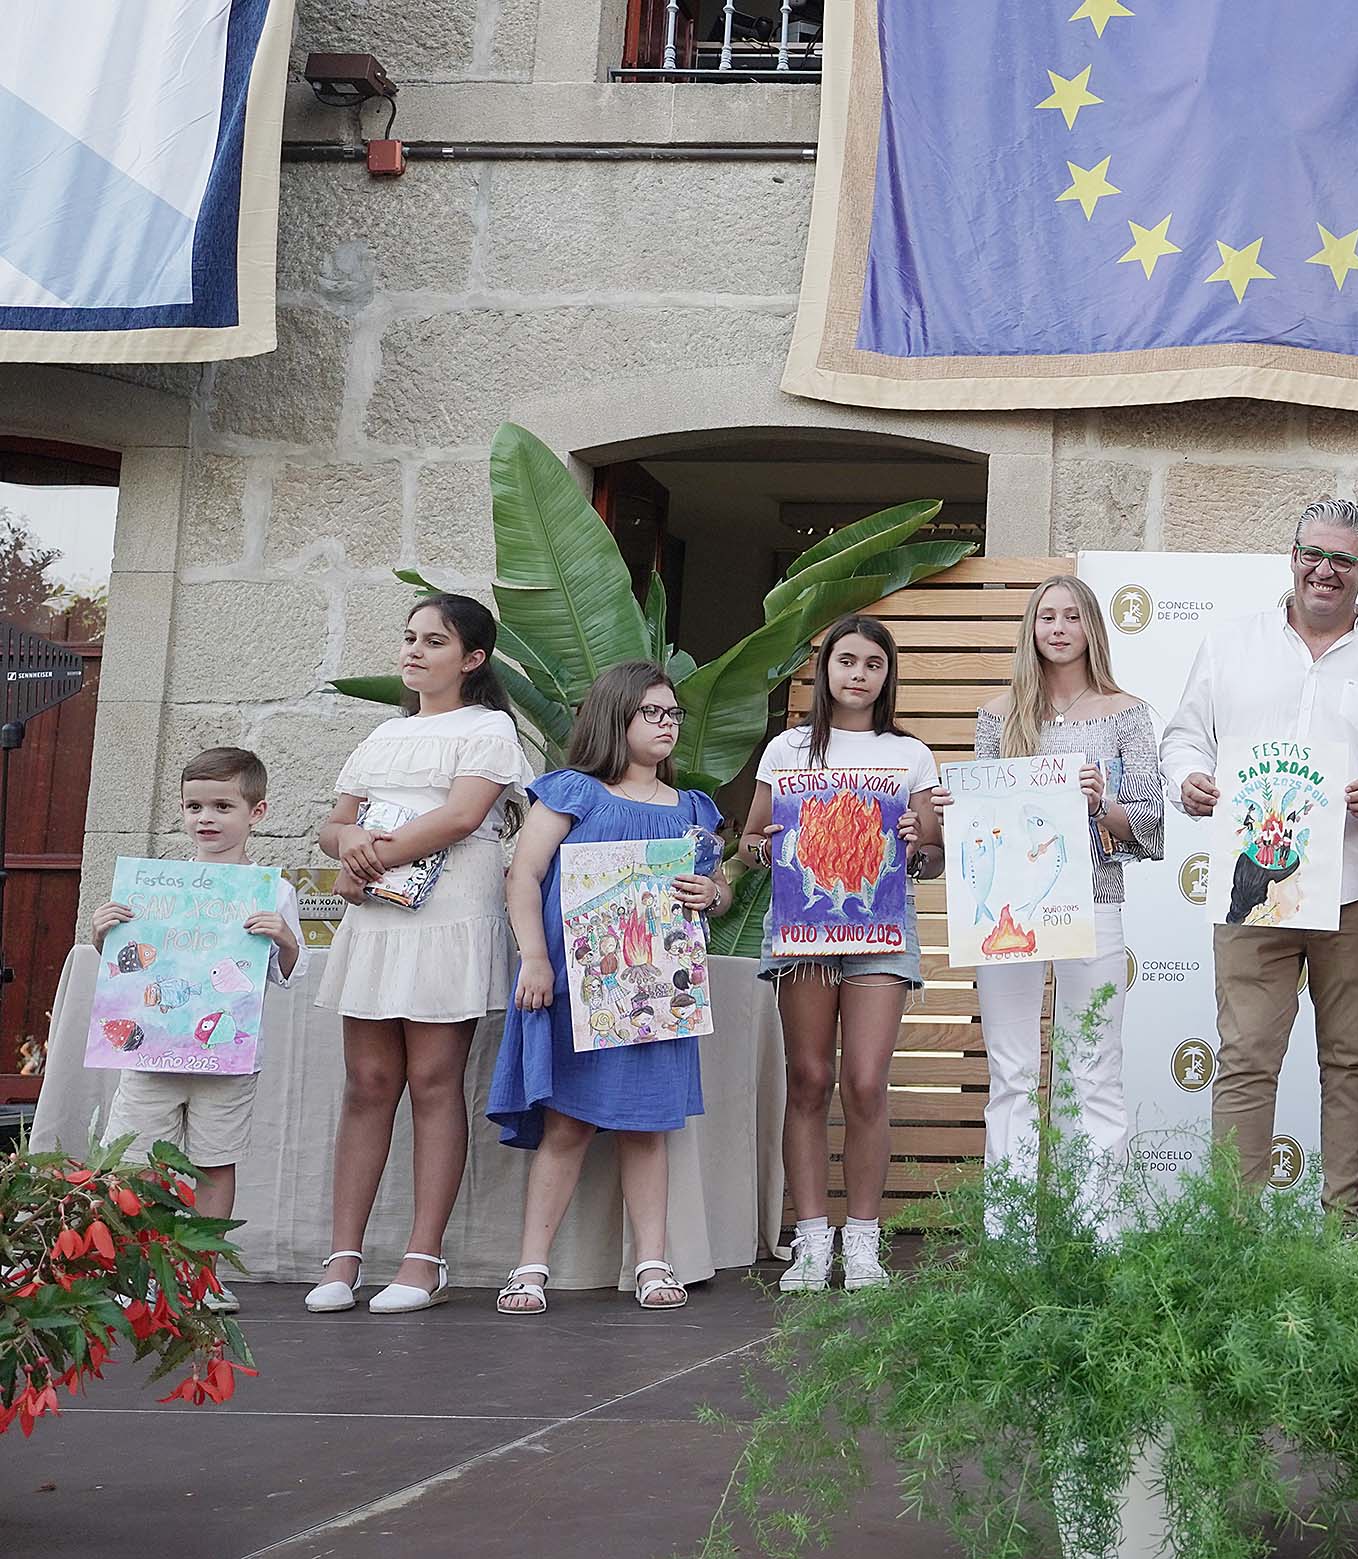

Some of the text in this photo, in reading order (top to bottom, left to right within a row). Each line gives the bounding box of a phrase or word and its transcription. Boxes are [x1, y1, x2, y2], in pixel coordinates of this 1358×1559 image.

[1157, 600, 1214, 610] CONCELLO
[1157, 611, 1200, 621] DE POIO
[18, 671, 53, 679] SENNHEISER
[1252, 741, 1312, 761] FESTAS
[945, 756, 1065, 791] FESTAS SAN
[1238, 760, 1271, 784] SAN
[778, 772, 829, 795] FESTAS
[831, 772, 859, 790] SAN
[135, 868, 214, 889] Festas de
[128, 892, 176, 921] SAN
[1042, 912, 1072, 927] POIO
[780, 925, 818, 944] POIO
[1142, 960, 1200, 971] CONCELLO
[1142, 972, 1185, 982] DE POIO
[184, 1055, 221, 1072] 2025
[1134, 1150, 1193, 1161] CONCELLO
[1149, 1162, 1178, 1172] POIO
